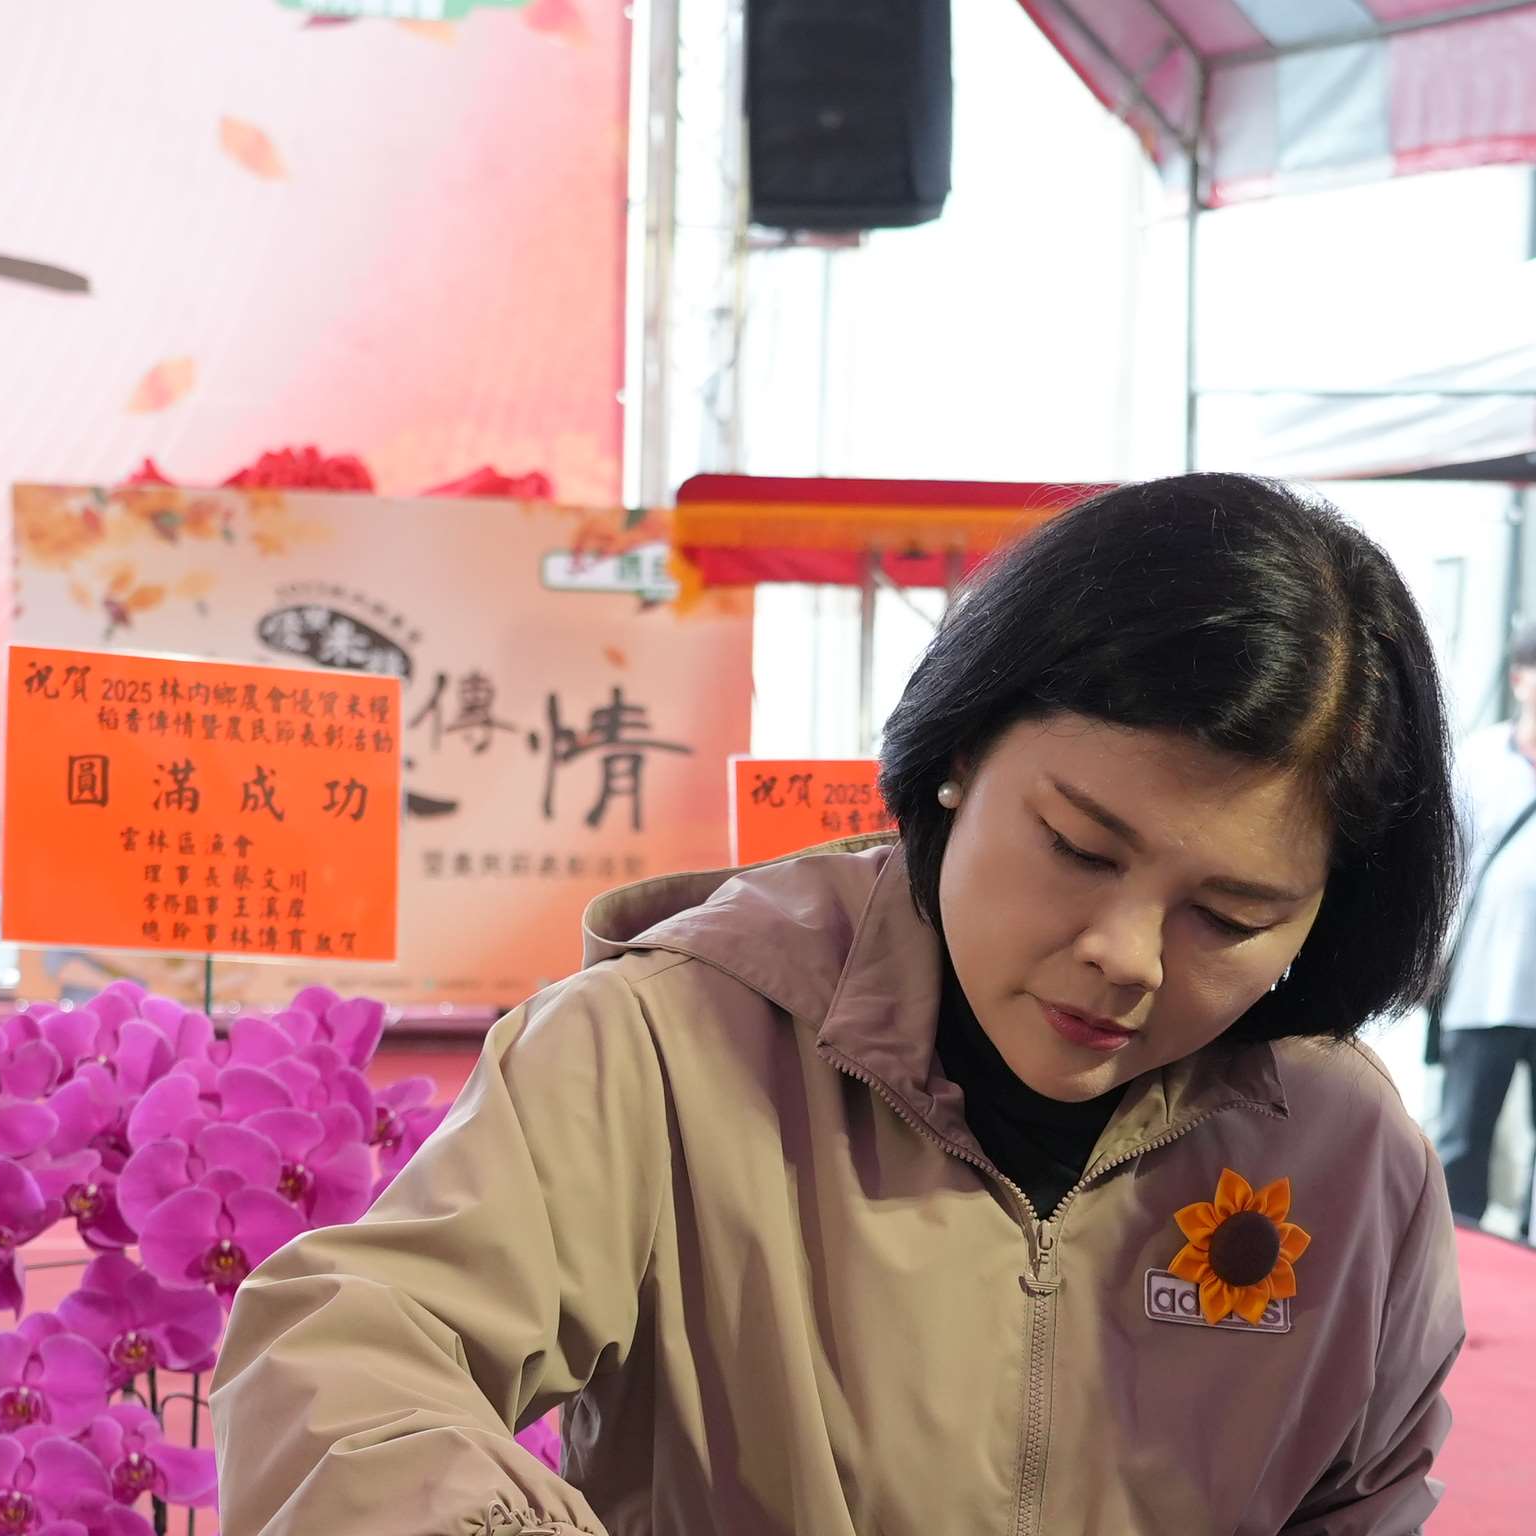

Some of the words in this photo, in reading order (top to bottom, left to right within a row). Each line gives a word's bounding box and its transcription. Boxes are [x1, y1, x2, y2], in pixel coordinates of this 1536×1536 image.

[404, 668, 694, 832] 傳情
[67, 754, 369, 822] 圓滿成功
[823, 783, 884, 806] 2025
